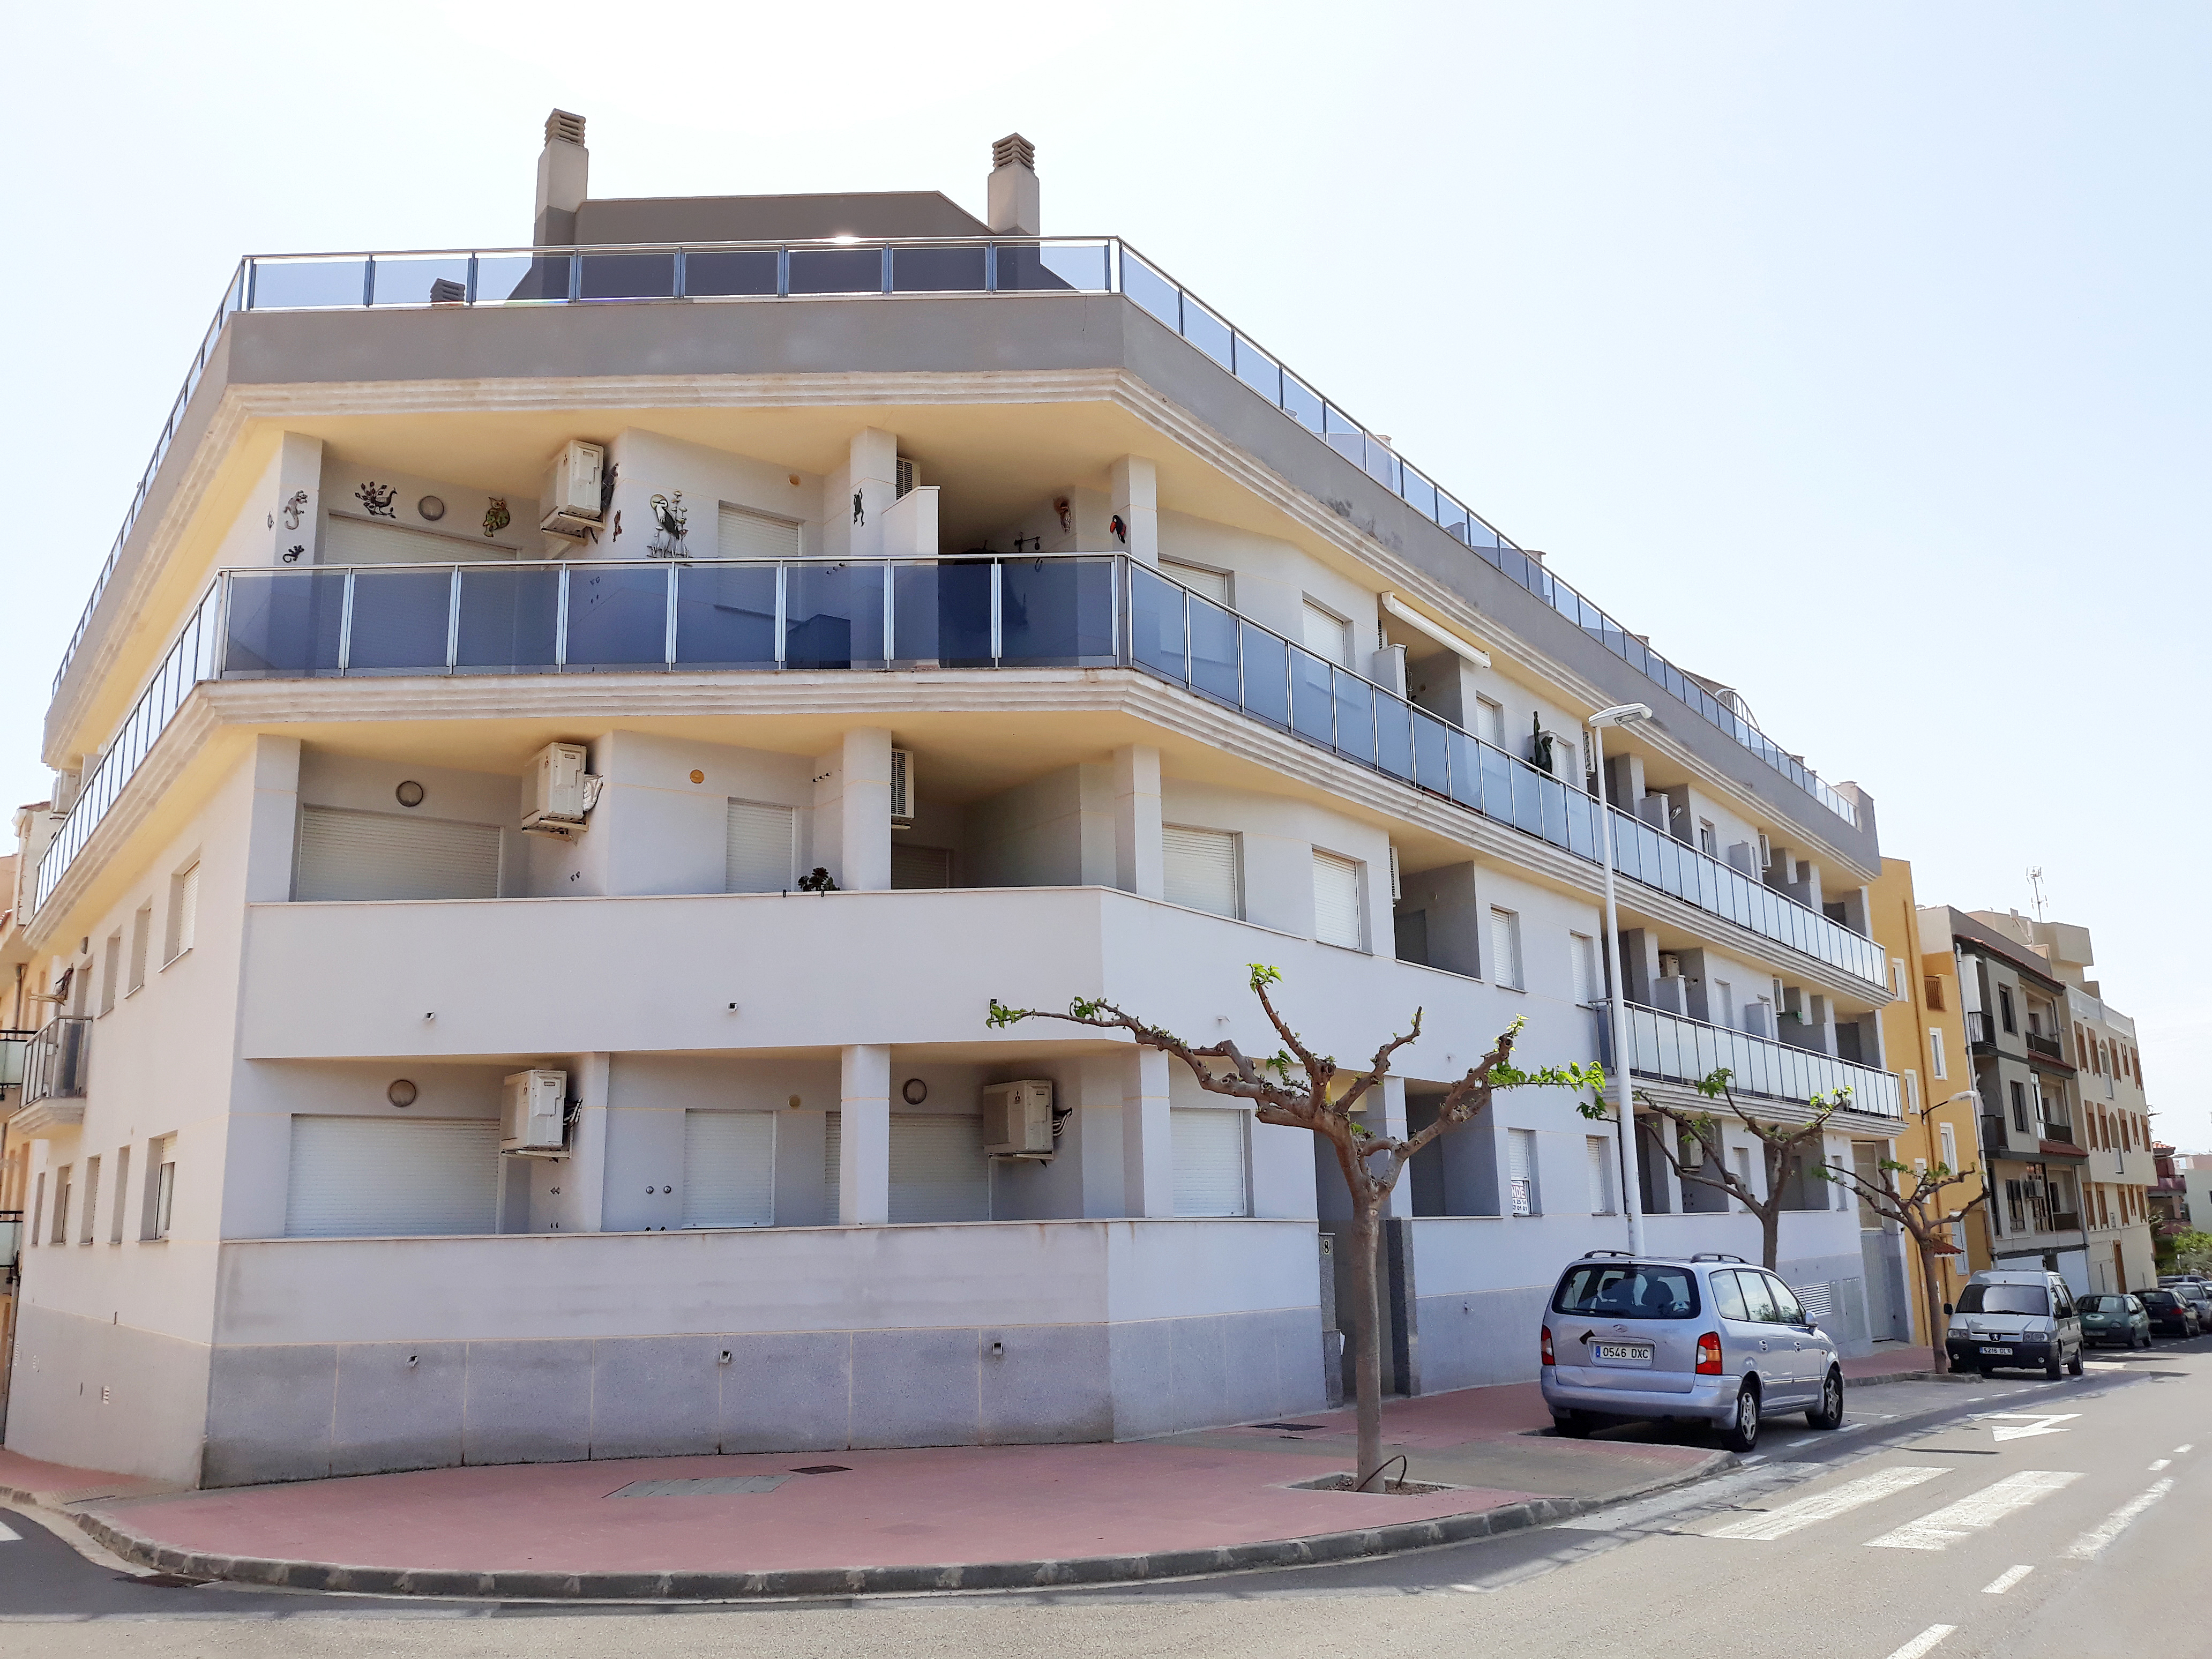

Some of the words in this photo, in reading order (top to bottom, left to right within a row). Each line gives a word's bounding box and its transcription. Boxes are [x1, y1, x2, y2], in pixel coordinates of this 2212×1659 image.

[1324, 1240, 1329, 1253] 8
[1603, 1347, 1626, 1357] 0546
[1631, 1348, 1649, 1358] DXC
